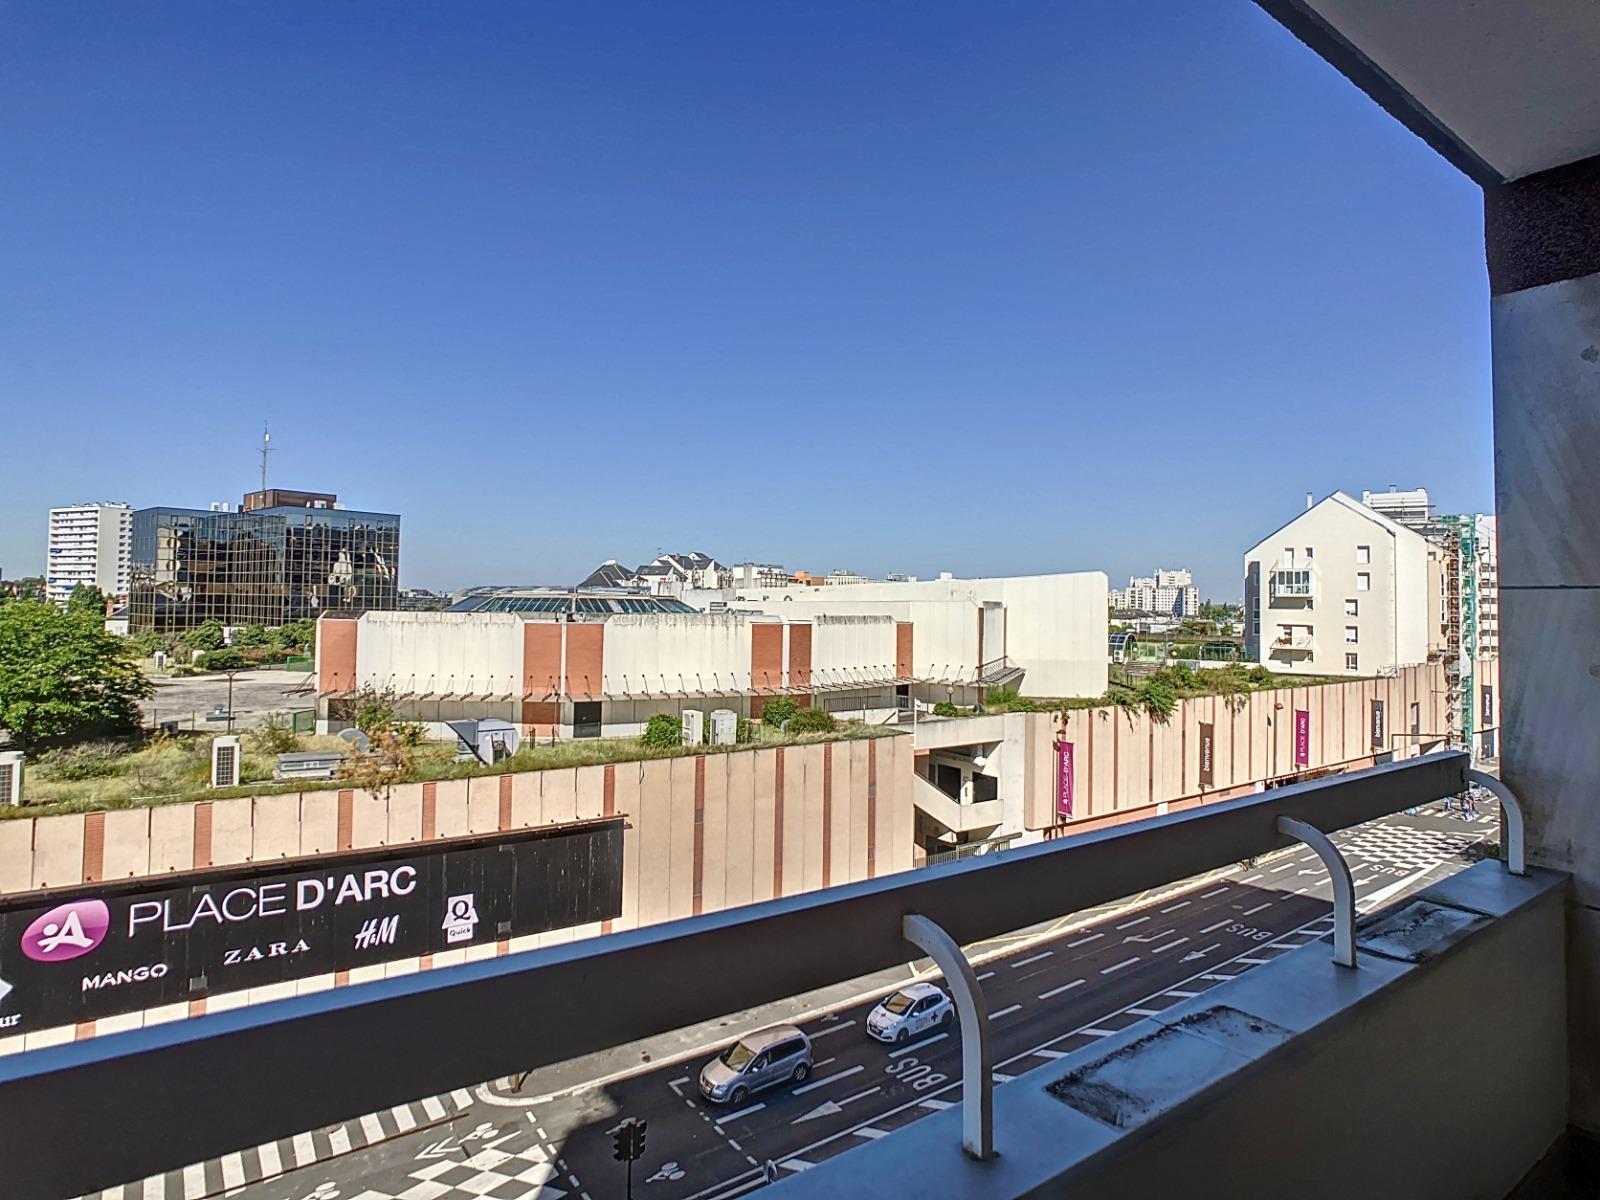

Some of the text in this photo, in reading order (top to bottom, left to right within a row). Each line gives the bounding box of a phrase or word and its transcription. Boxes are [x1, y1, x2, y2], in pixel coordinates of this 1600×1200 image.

[1369, 864, 1410, 877] BUS
[128, 865, 417, 938] PLACE D'ARC
[354, 914, 400, 950] H&M
[450, 927, 471, 937] Quick
[1225, 923, 1273, 941] BUS
[223, 938, 311, 966] ZARA
[82, 963, 168, 992] MANGO
[885, 1057, 948, 1091] BUS
